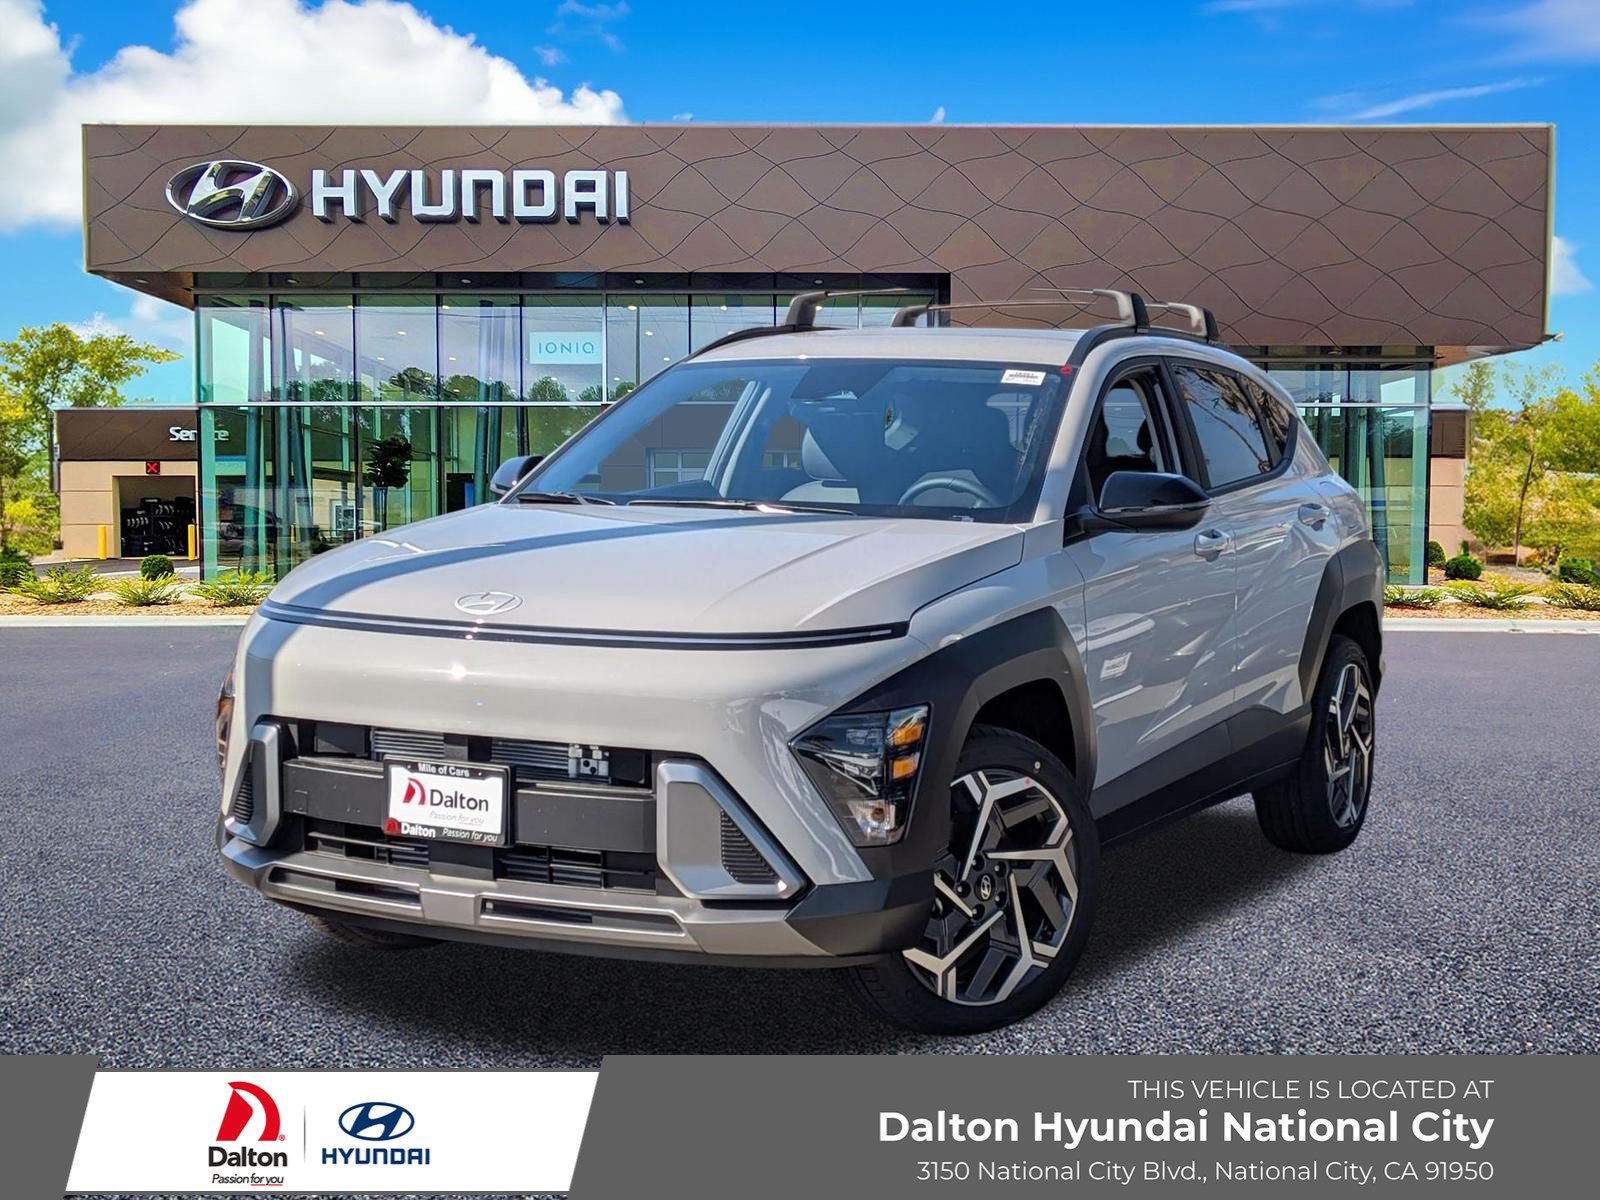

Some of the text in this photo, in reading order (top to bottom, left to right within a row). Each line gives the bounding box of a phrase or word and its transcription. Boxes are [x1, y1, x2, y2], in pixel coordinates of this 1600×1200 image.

[312, 169, 631, 224] HYUNDAI
[538, 341, 595, 354] IONIQ
[418, 762, 470, 777] Mile of Cars
[430, 788, 489, 812] Dalton
[401, 822, 498, 843] Dalton Passion for you
